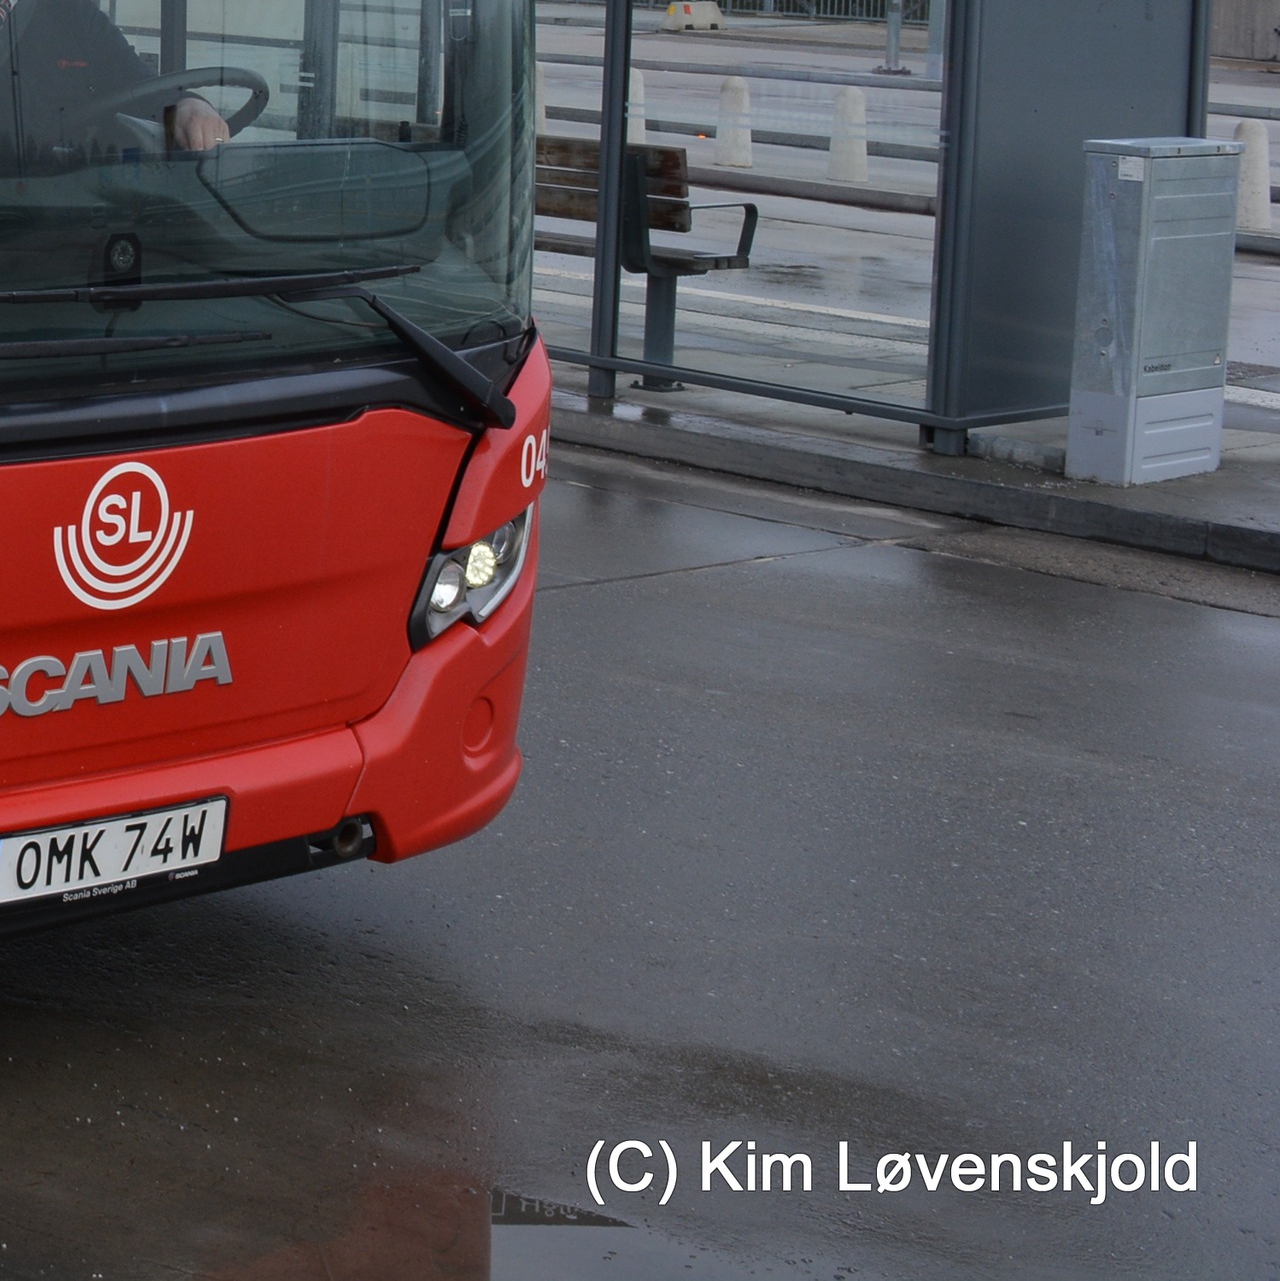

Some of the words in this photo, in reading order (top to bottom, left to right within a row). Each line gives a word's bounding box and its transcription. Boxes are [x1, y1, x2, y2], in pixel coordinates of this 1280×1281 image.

[521, 425, 550, 488] 04
[95, 491, 153, 546] SL
[15, 828, 106, 890] OMK
[121, 809, 208, 872] 74W
[62, 892, 91, 902] Scania
[92, 883, 124, 897] Sverige
[124, 879, 137, 890] AB
